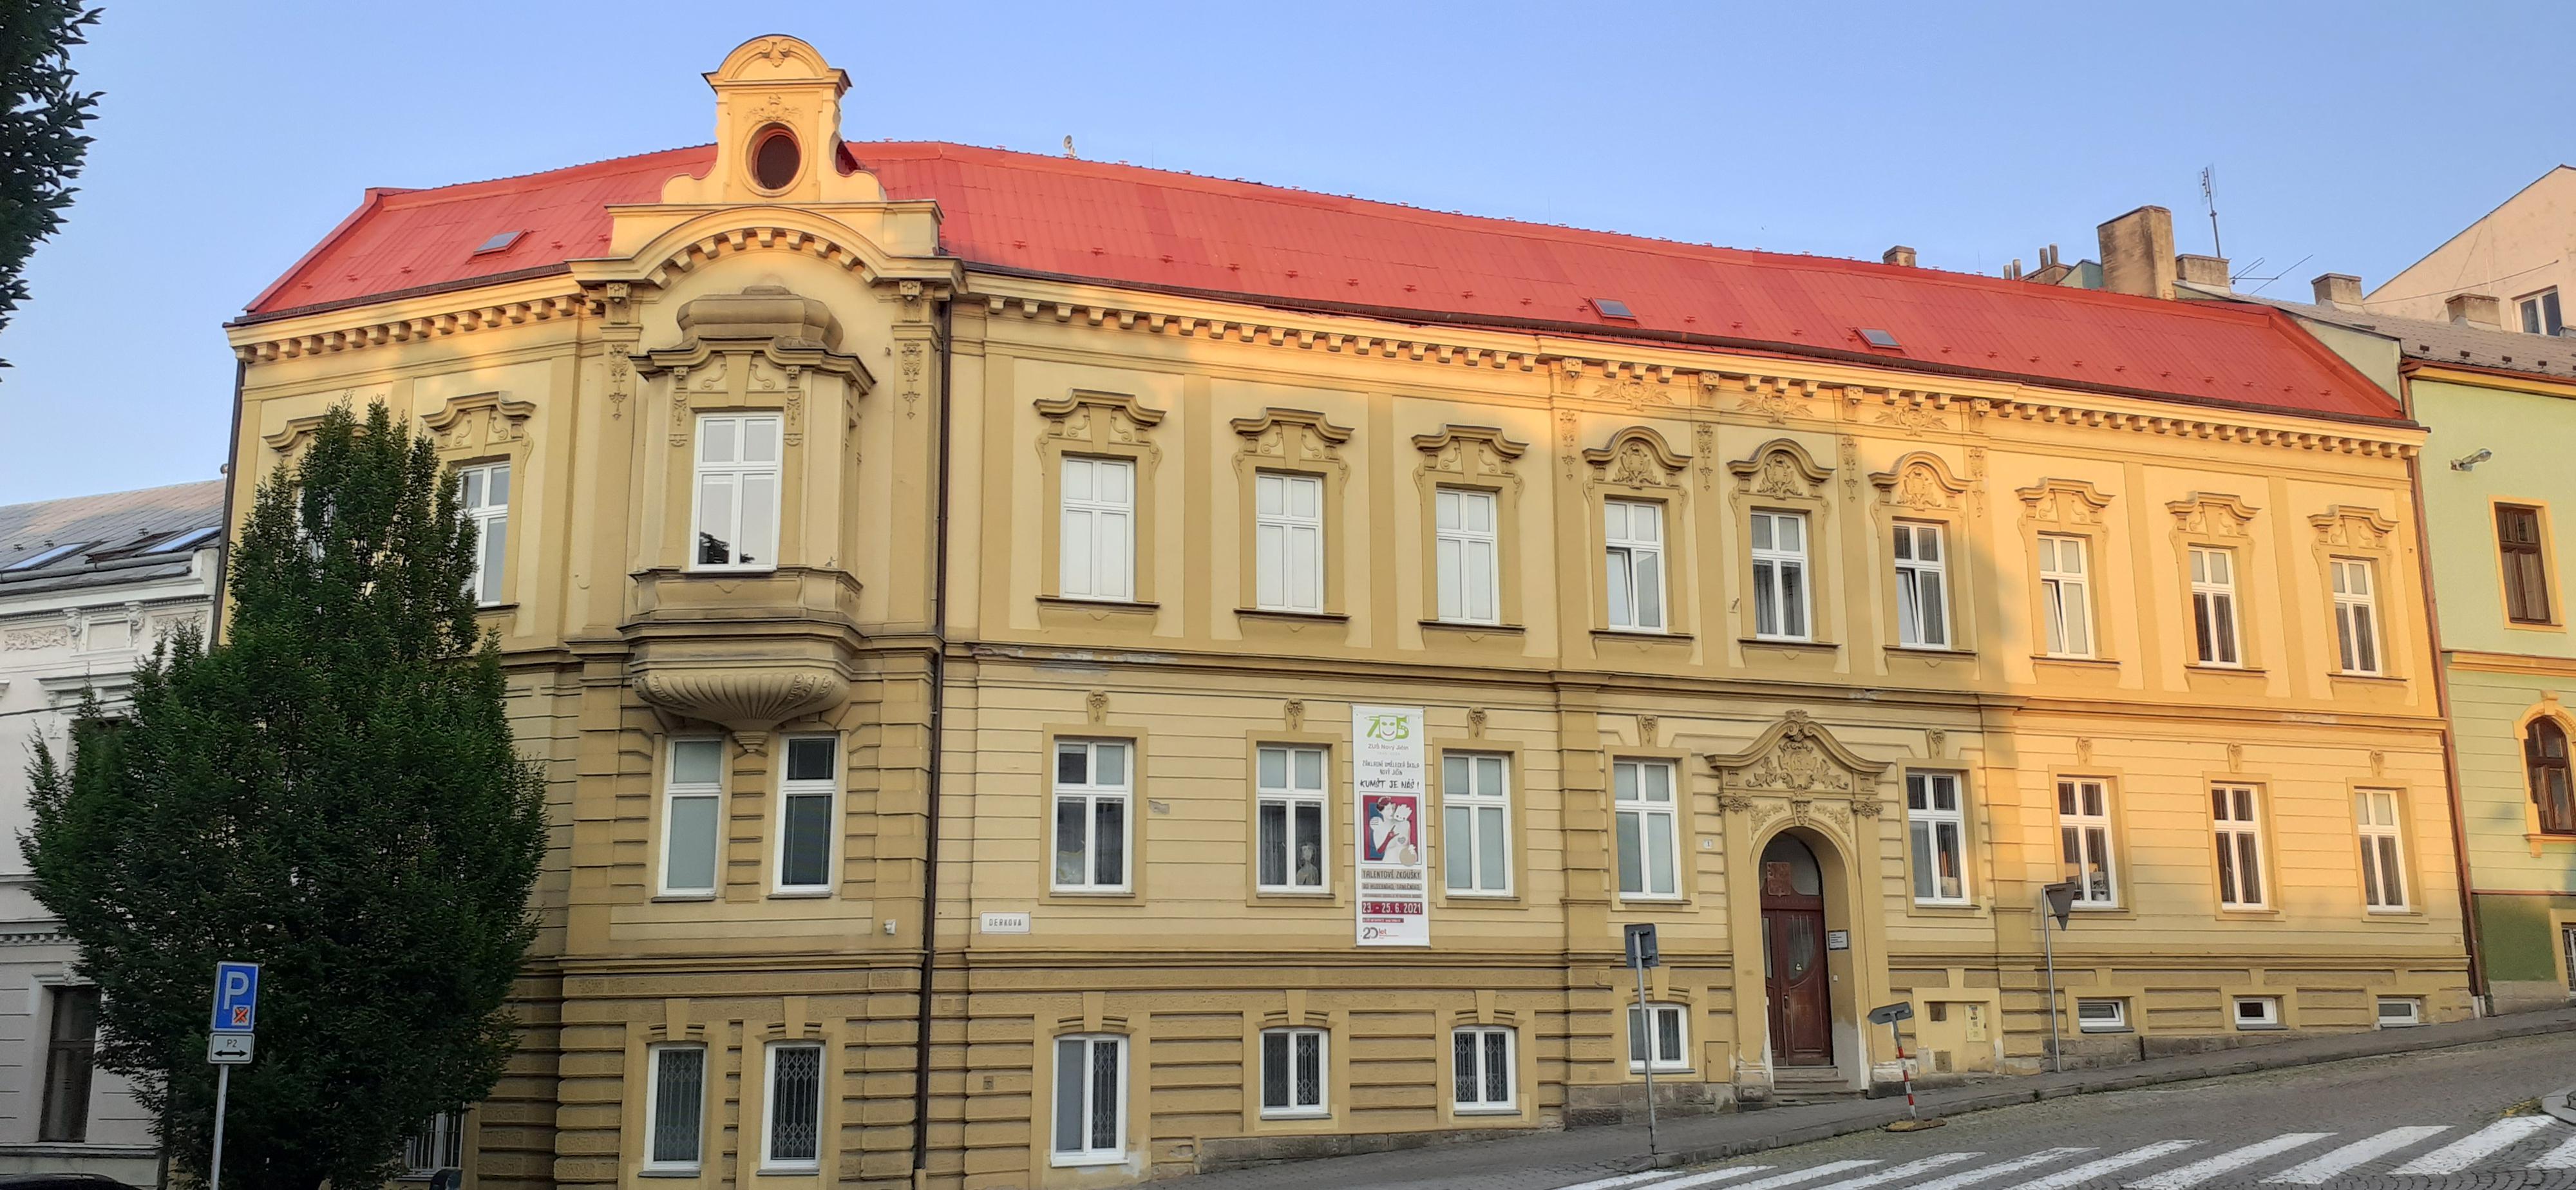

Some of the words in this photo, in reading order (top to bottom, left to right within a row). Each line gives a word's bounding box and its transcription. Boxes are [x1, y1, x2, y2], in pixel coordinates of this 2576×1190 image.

[1360, 778, 1386, 788] KUMŠT
[1363, 869, 1394, 879] TALENTOVÉ
[1396, 870, 1421, 880] ZKOUŠKY
[1363, 902, 1374, 913] 23.
[1381, 903, 1393, 913] 25.
[1395, 903, 1401, 913] 6.
[1404, 903, 1421, 914] 2021
[223, 971, 249, 1010] P
[227, 1039, 238, 1048] P2
